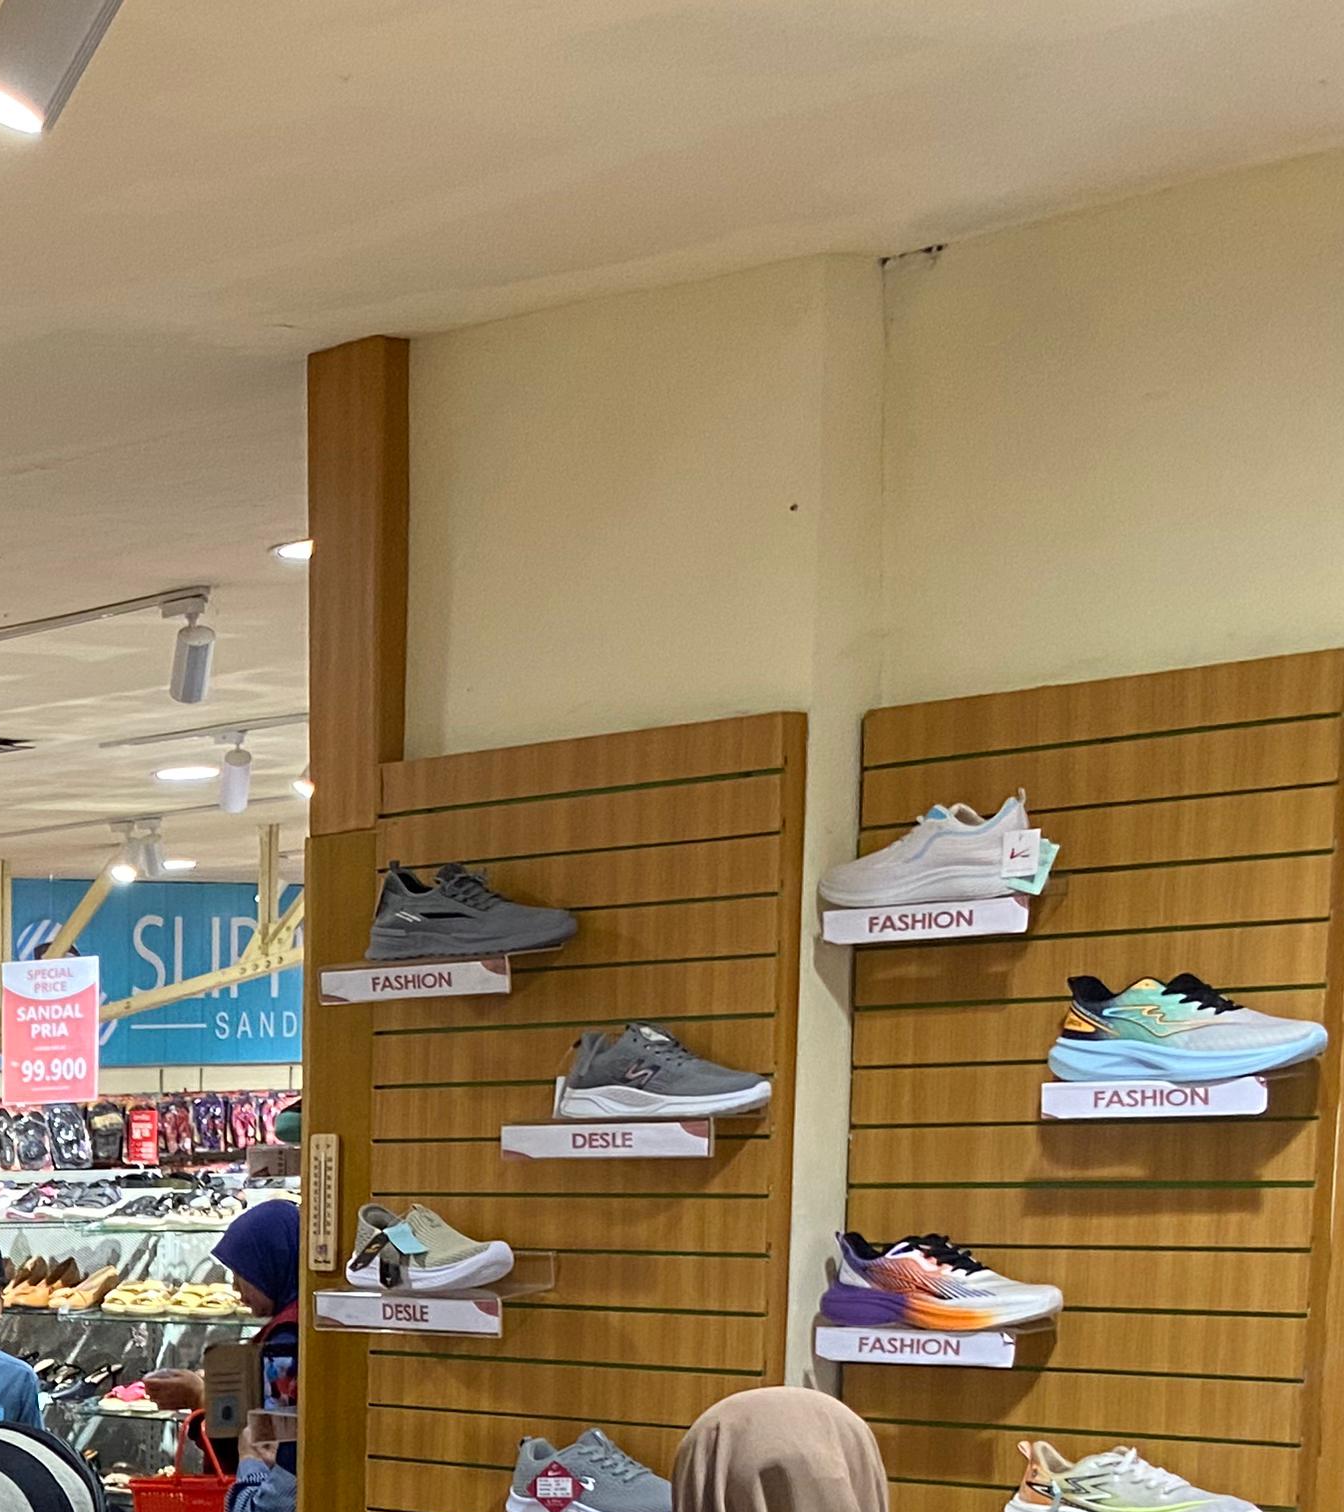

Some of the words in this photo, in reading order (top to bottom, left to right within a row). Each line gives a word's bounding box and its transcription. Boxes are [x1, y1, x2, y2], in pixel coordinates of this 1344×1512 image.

[867, 908, 974, 934] FASHION
[26, 967, 73, 980] SPECIAL
[370, 971, 453, 993] FASHION
[34, 980, 68, 993] PRICE
[15, 1003, 84, 1021] SANDAL
[30, 1022, 69, 1039] PRIA
[20, 1057, 87, 1082] 99.900
[1092, 1086, 1210, 1110] FASHION
[570, 1129, 633, 1151] DESLE
[380, 1301, 430, 1325] DESLE
[857, 1335, 961, 1359] FASHION
